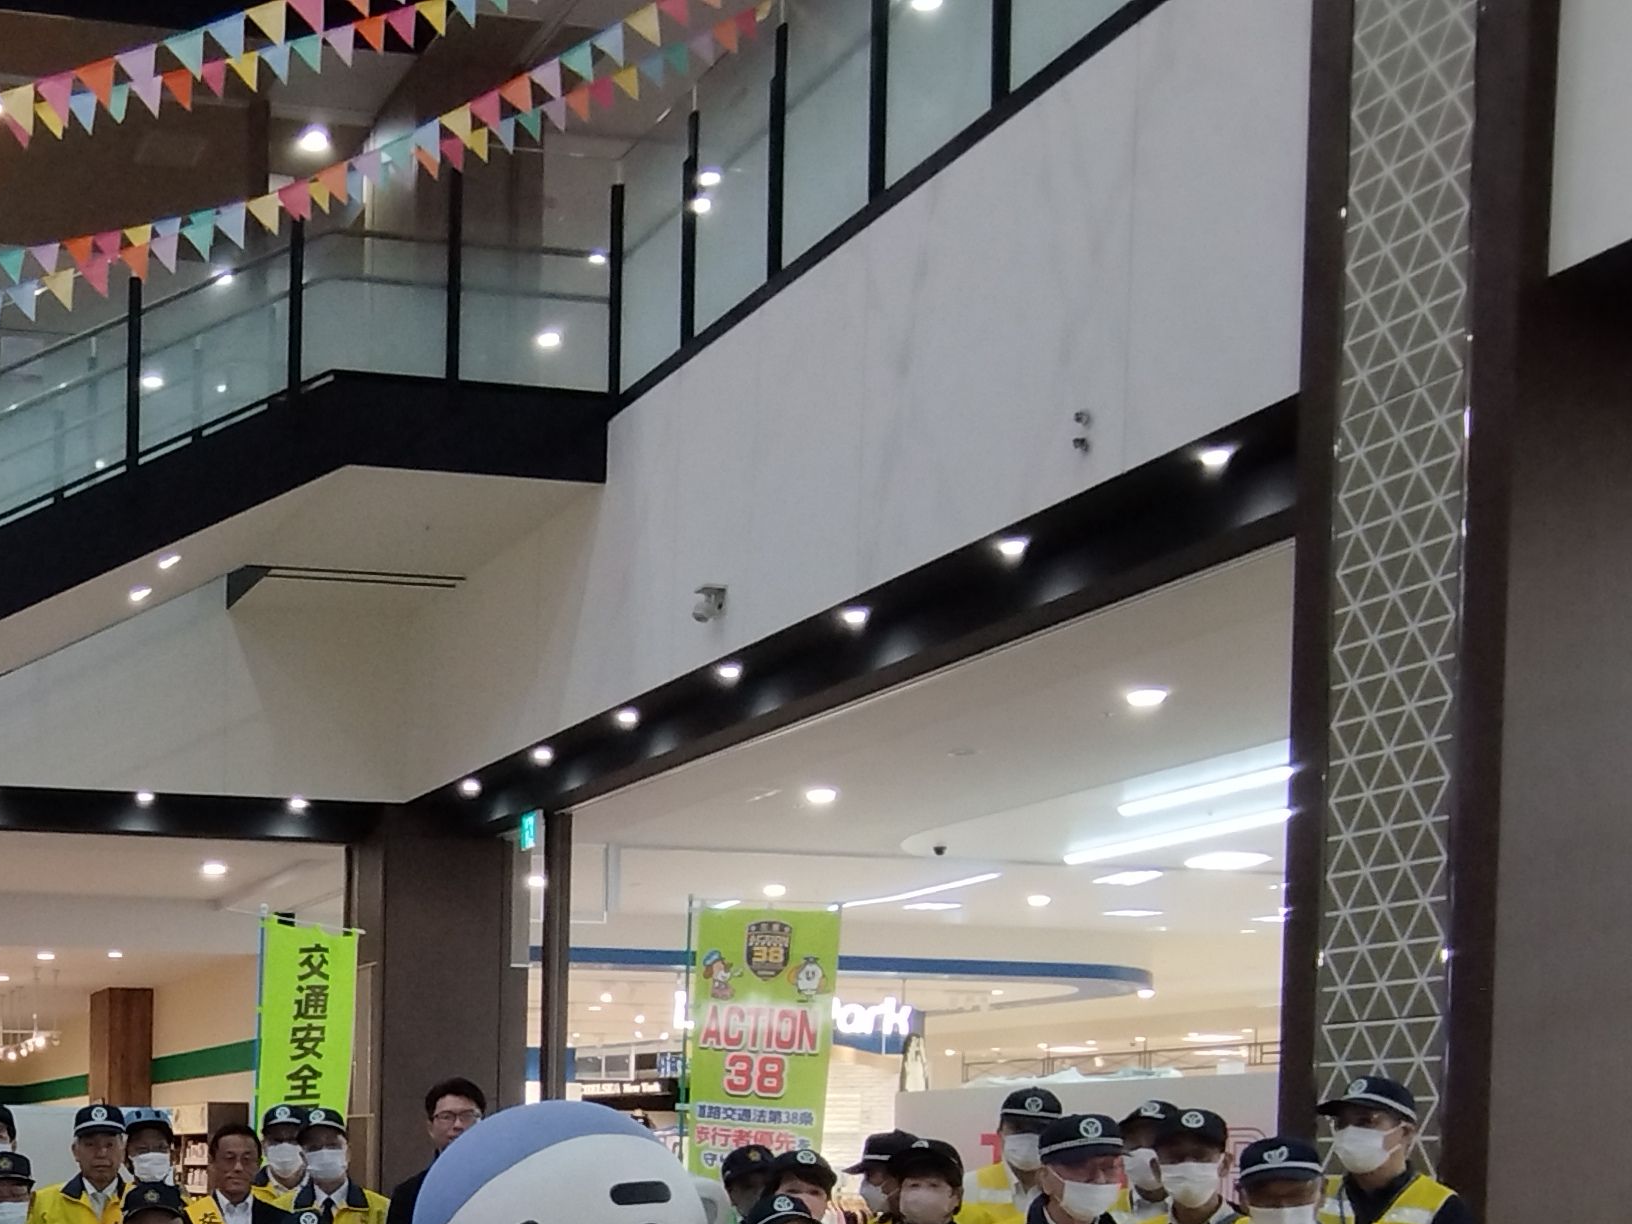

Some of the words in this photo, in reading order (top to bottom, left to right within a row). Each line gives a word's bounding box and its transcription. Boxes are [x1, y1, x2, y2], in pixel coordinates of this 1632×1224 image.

[751, 946, 785, 963] 38
[282, 942, 331, 1109] 交通安全
[700, 1004, 819, 1055] ACTION
[724, 1052, 787, 1095] 38
